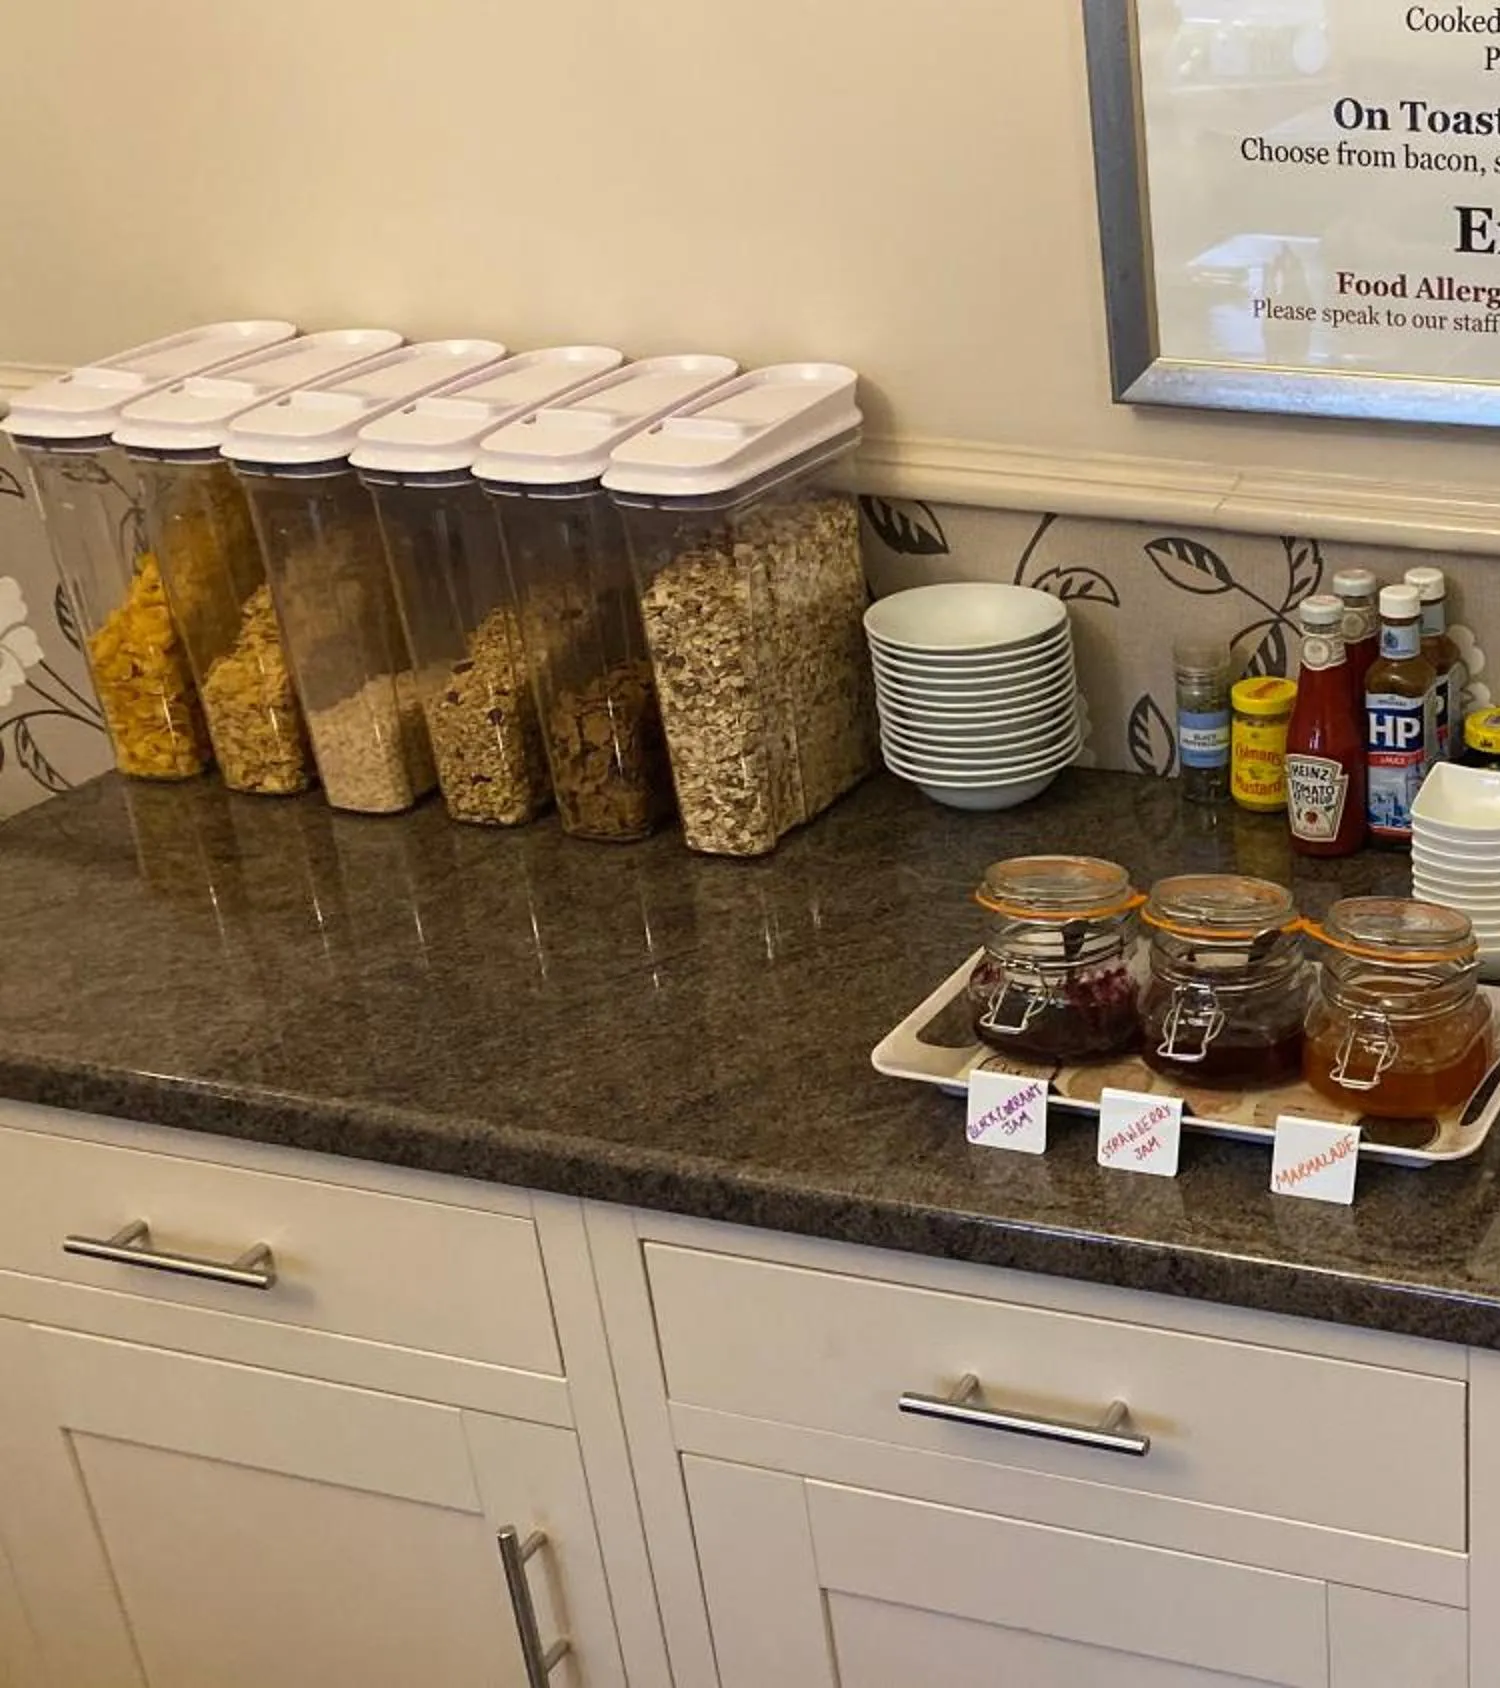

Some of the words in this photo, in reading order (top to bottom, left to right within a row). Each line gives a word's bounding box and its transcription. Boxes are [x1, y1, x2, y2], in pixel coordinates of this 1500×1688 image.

[1333, 97, 1391, 132] On
[1241, 137, 1330, 165] Choose
[1336, 141, 1397, 168] from
[1404, 144, 1486, 176] bacon,
[1336, 272, 1407, 299] Food
[1253, 299, 1317, 321] Please
[1322, 306, 1381, 328] speak
[1386, 309, 1407, 327] to
[1411, 312, 1448, 331] our
[1453, 312, 1500, 334] staff
[1369, 711, 1421, 748] HP
[1291, 765, 1329, 781] HEINZ
[1291, 779, 1335, 796] TOMATO
[1001, 1111, 1033, 1136] JAM
[1101, 1104, 1171, 1159] STRAWBERRY
[1133, 1135, 1161, 1161] JAM
[1275, 1132, 1355, 1190] MARMALADE
